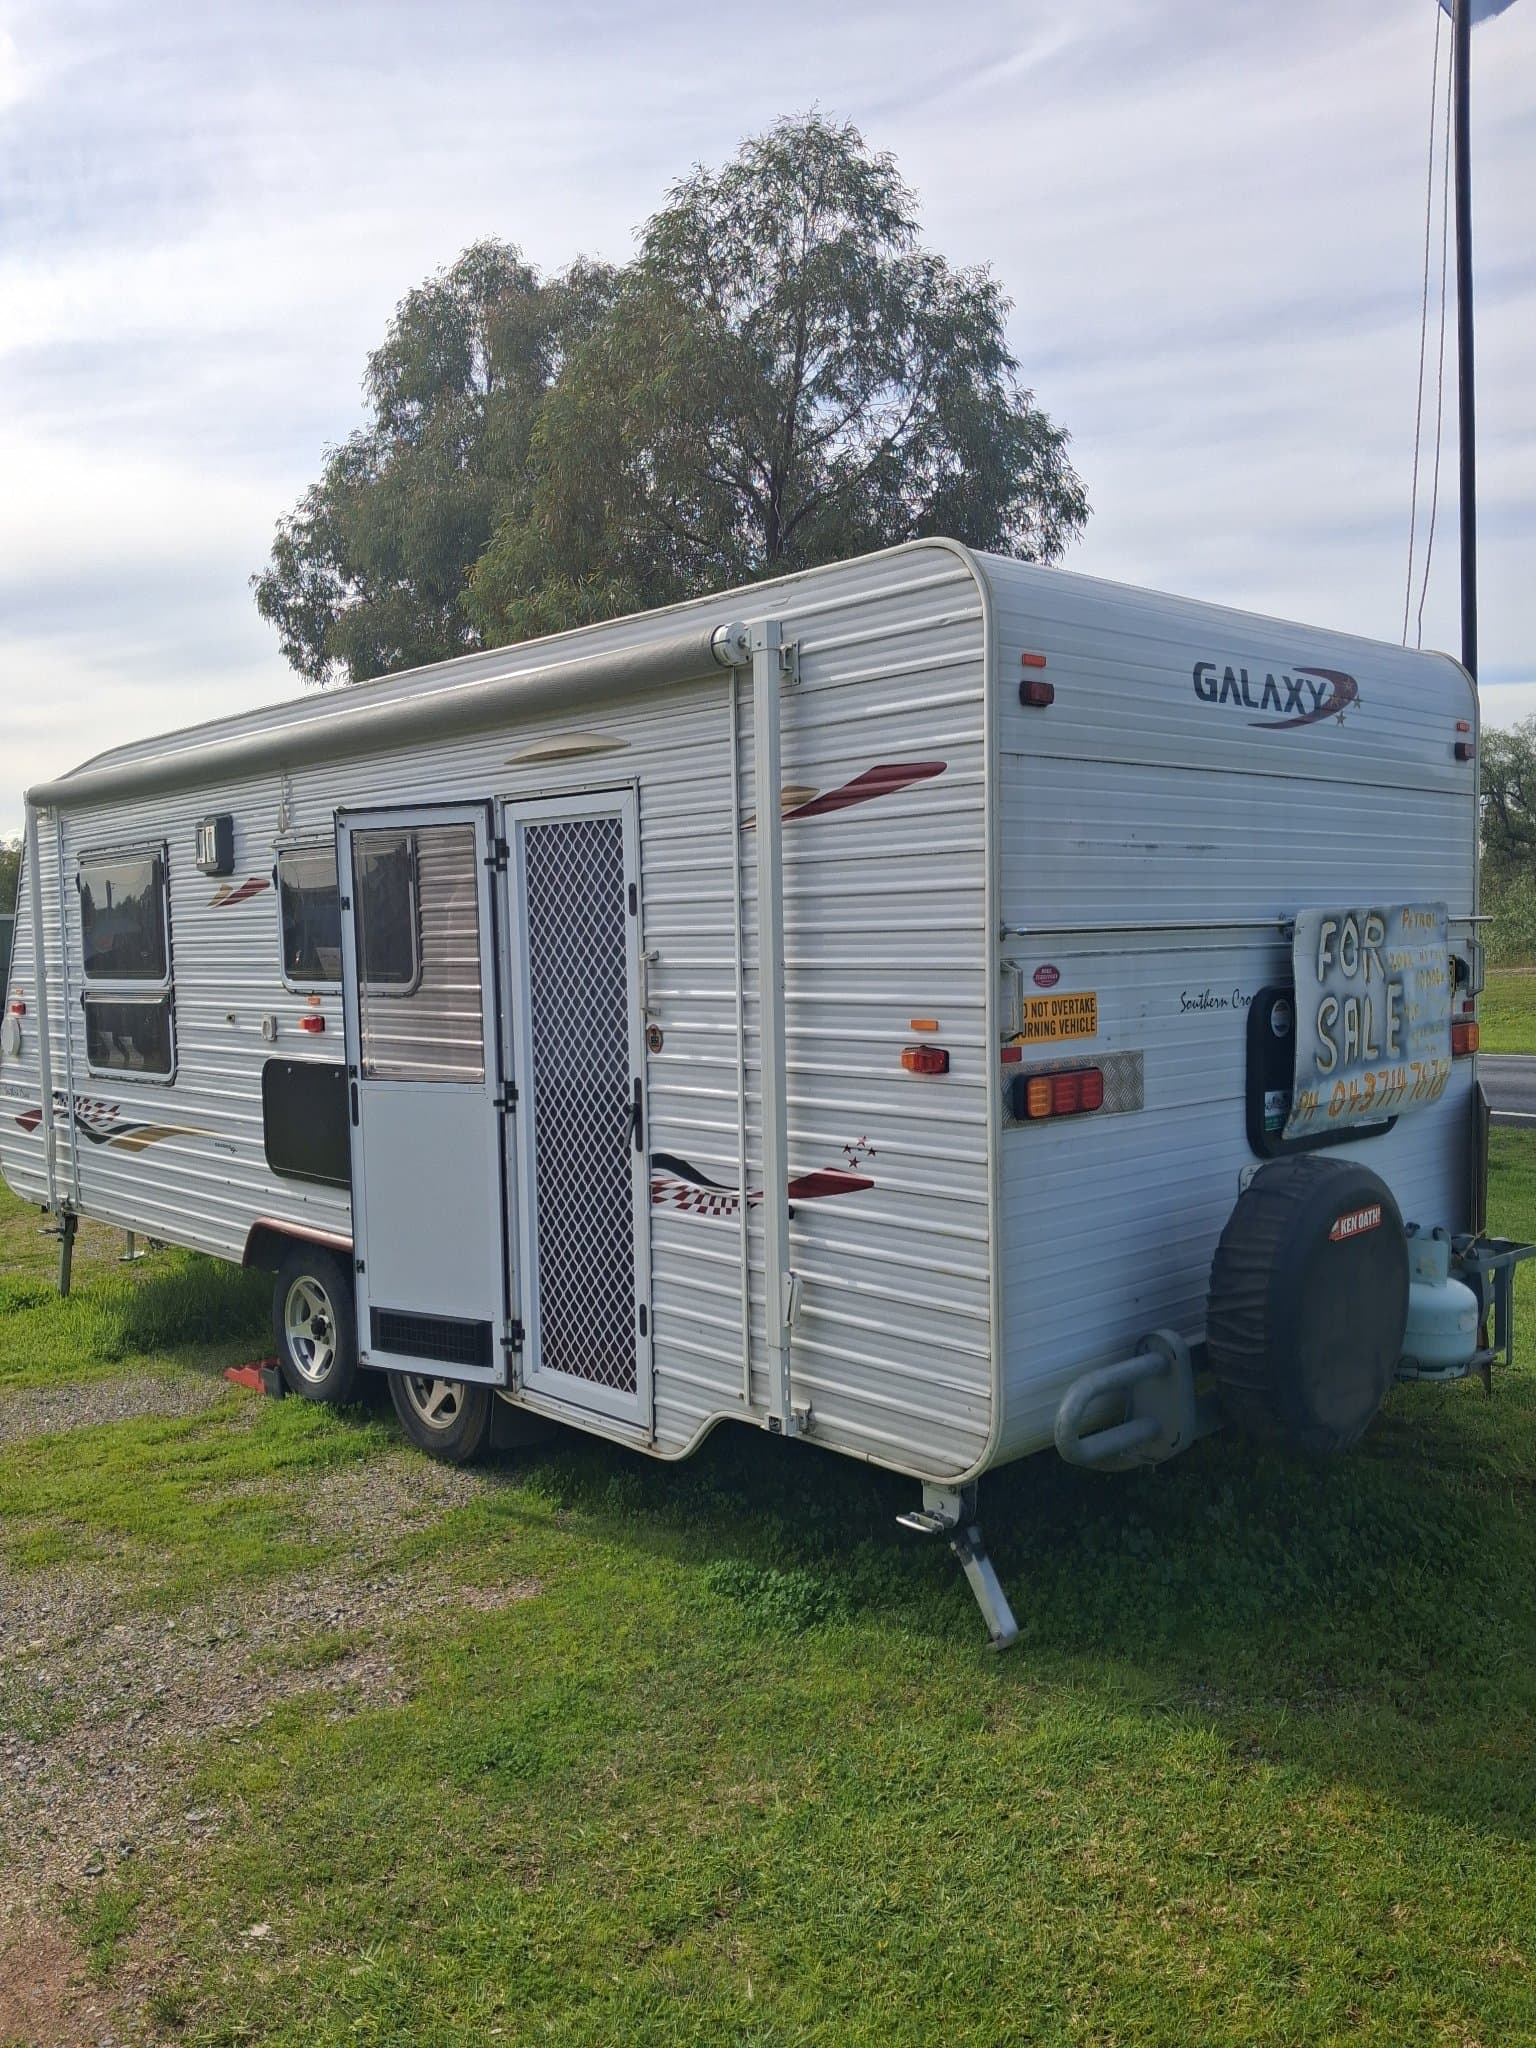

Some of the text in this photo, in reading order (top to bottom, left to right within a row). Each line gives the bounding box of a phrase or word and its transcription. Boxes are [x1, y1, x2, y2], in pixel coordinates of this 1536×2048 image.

[1193, 661, 1327, 715] GALAXY
[1317, 913, 1385, 984] FOR
[1031, 1001, 1049, 1018] NOT
[1052, 997, 1096, 1017] OVERTAKE
[1180, 988, 1256, 1013] Southern Cro
[1017, 1016, 1096, 1039] URNING VEHICLE
[1315, 983, 1405, 1076] SALE
[1341, 1207, 1381, 1236] KEN OATH!
